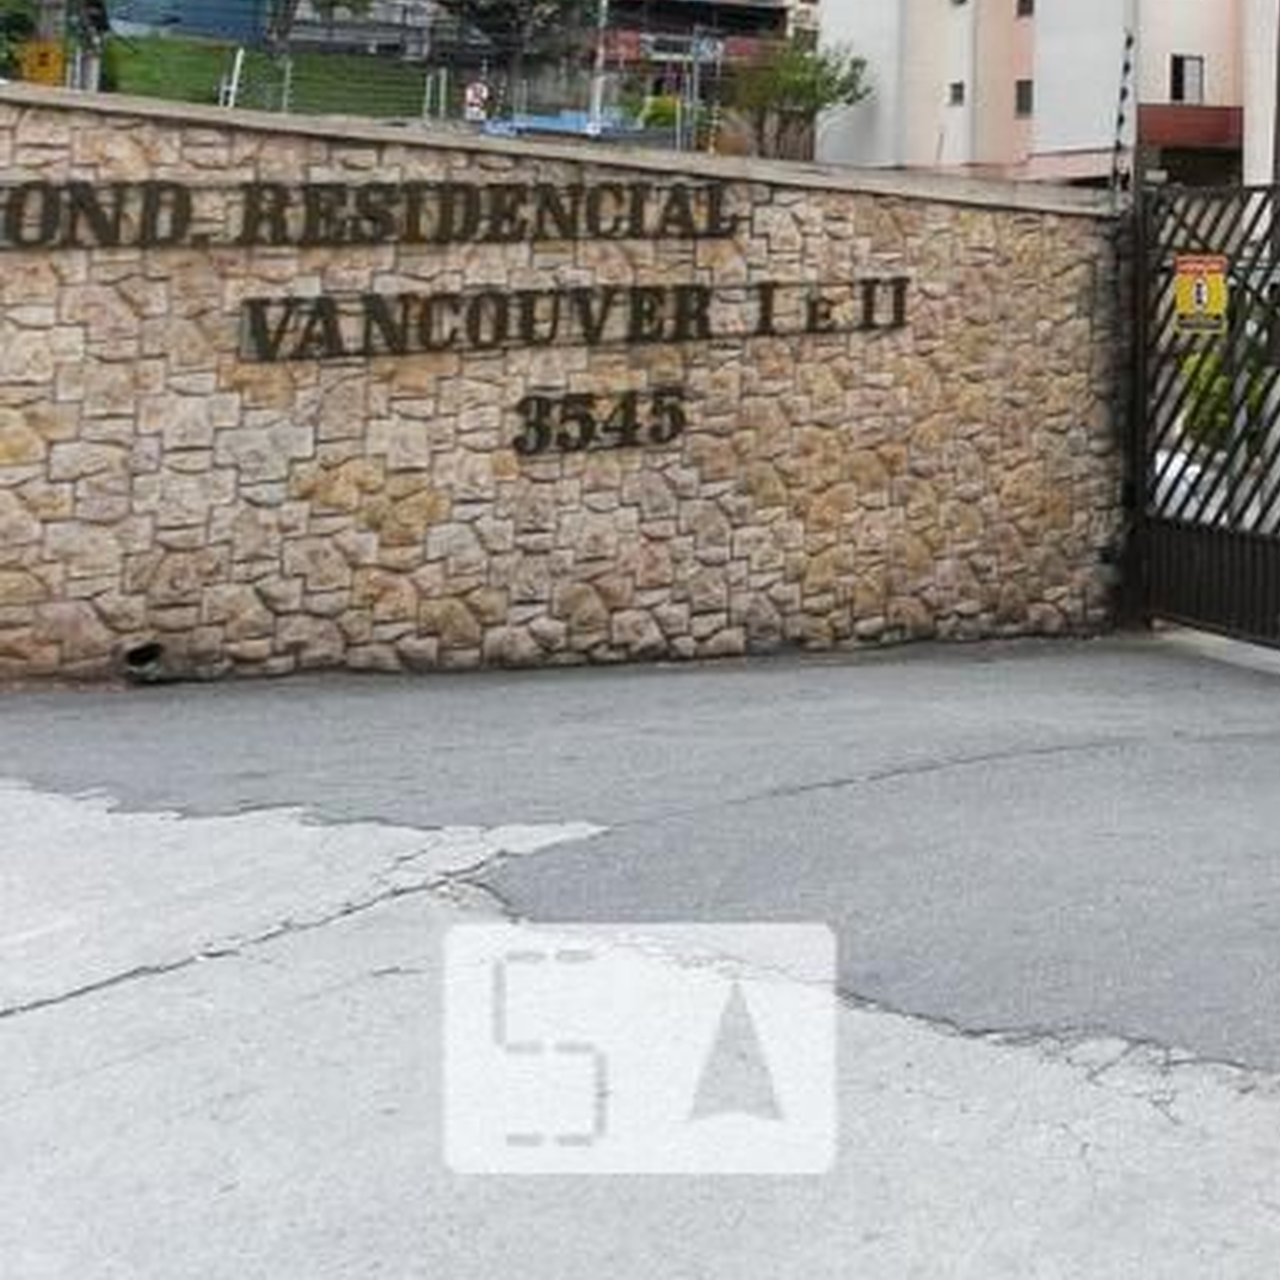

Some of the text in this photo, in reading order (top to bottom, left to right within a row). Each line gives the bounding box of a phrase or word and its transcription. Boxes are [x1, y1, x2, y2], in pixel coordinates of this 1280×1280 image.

[0, 179, 741, 249] OND. RESIDENCIAL
[239, 283, 712, 361] VANCOUVER
[512, 383, 688, 457] 3545
